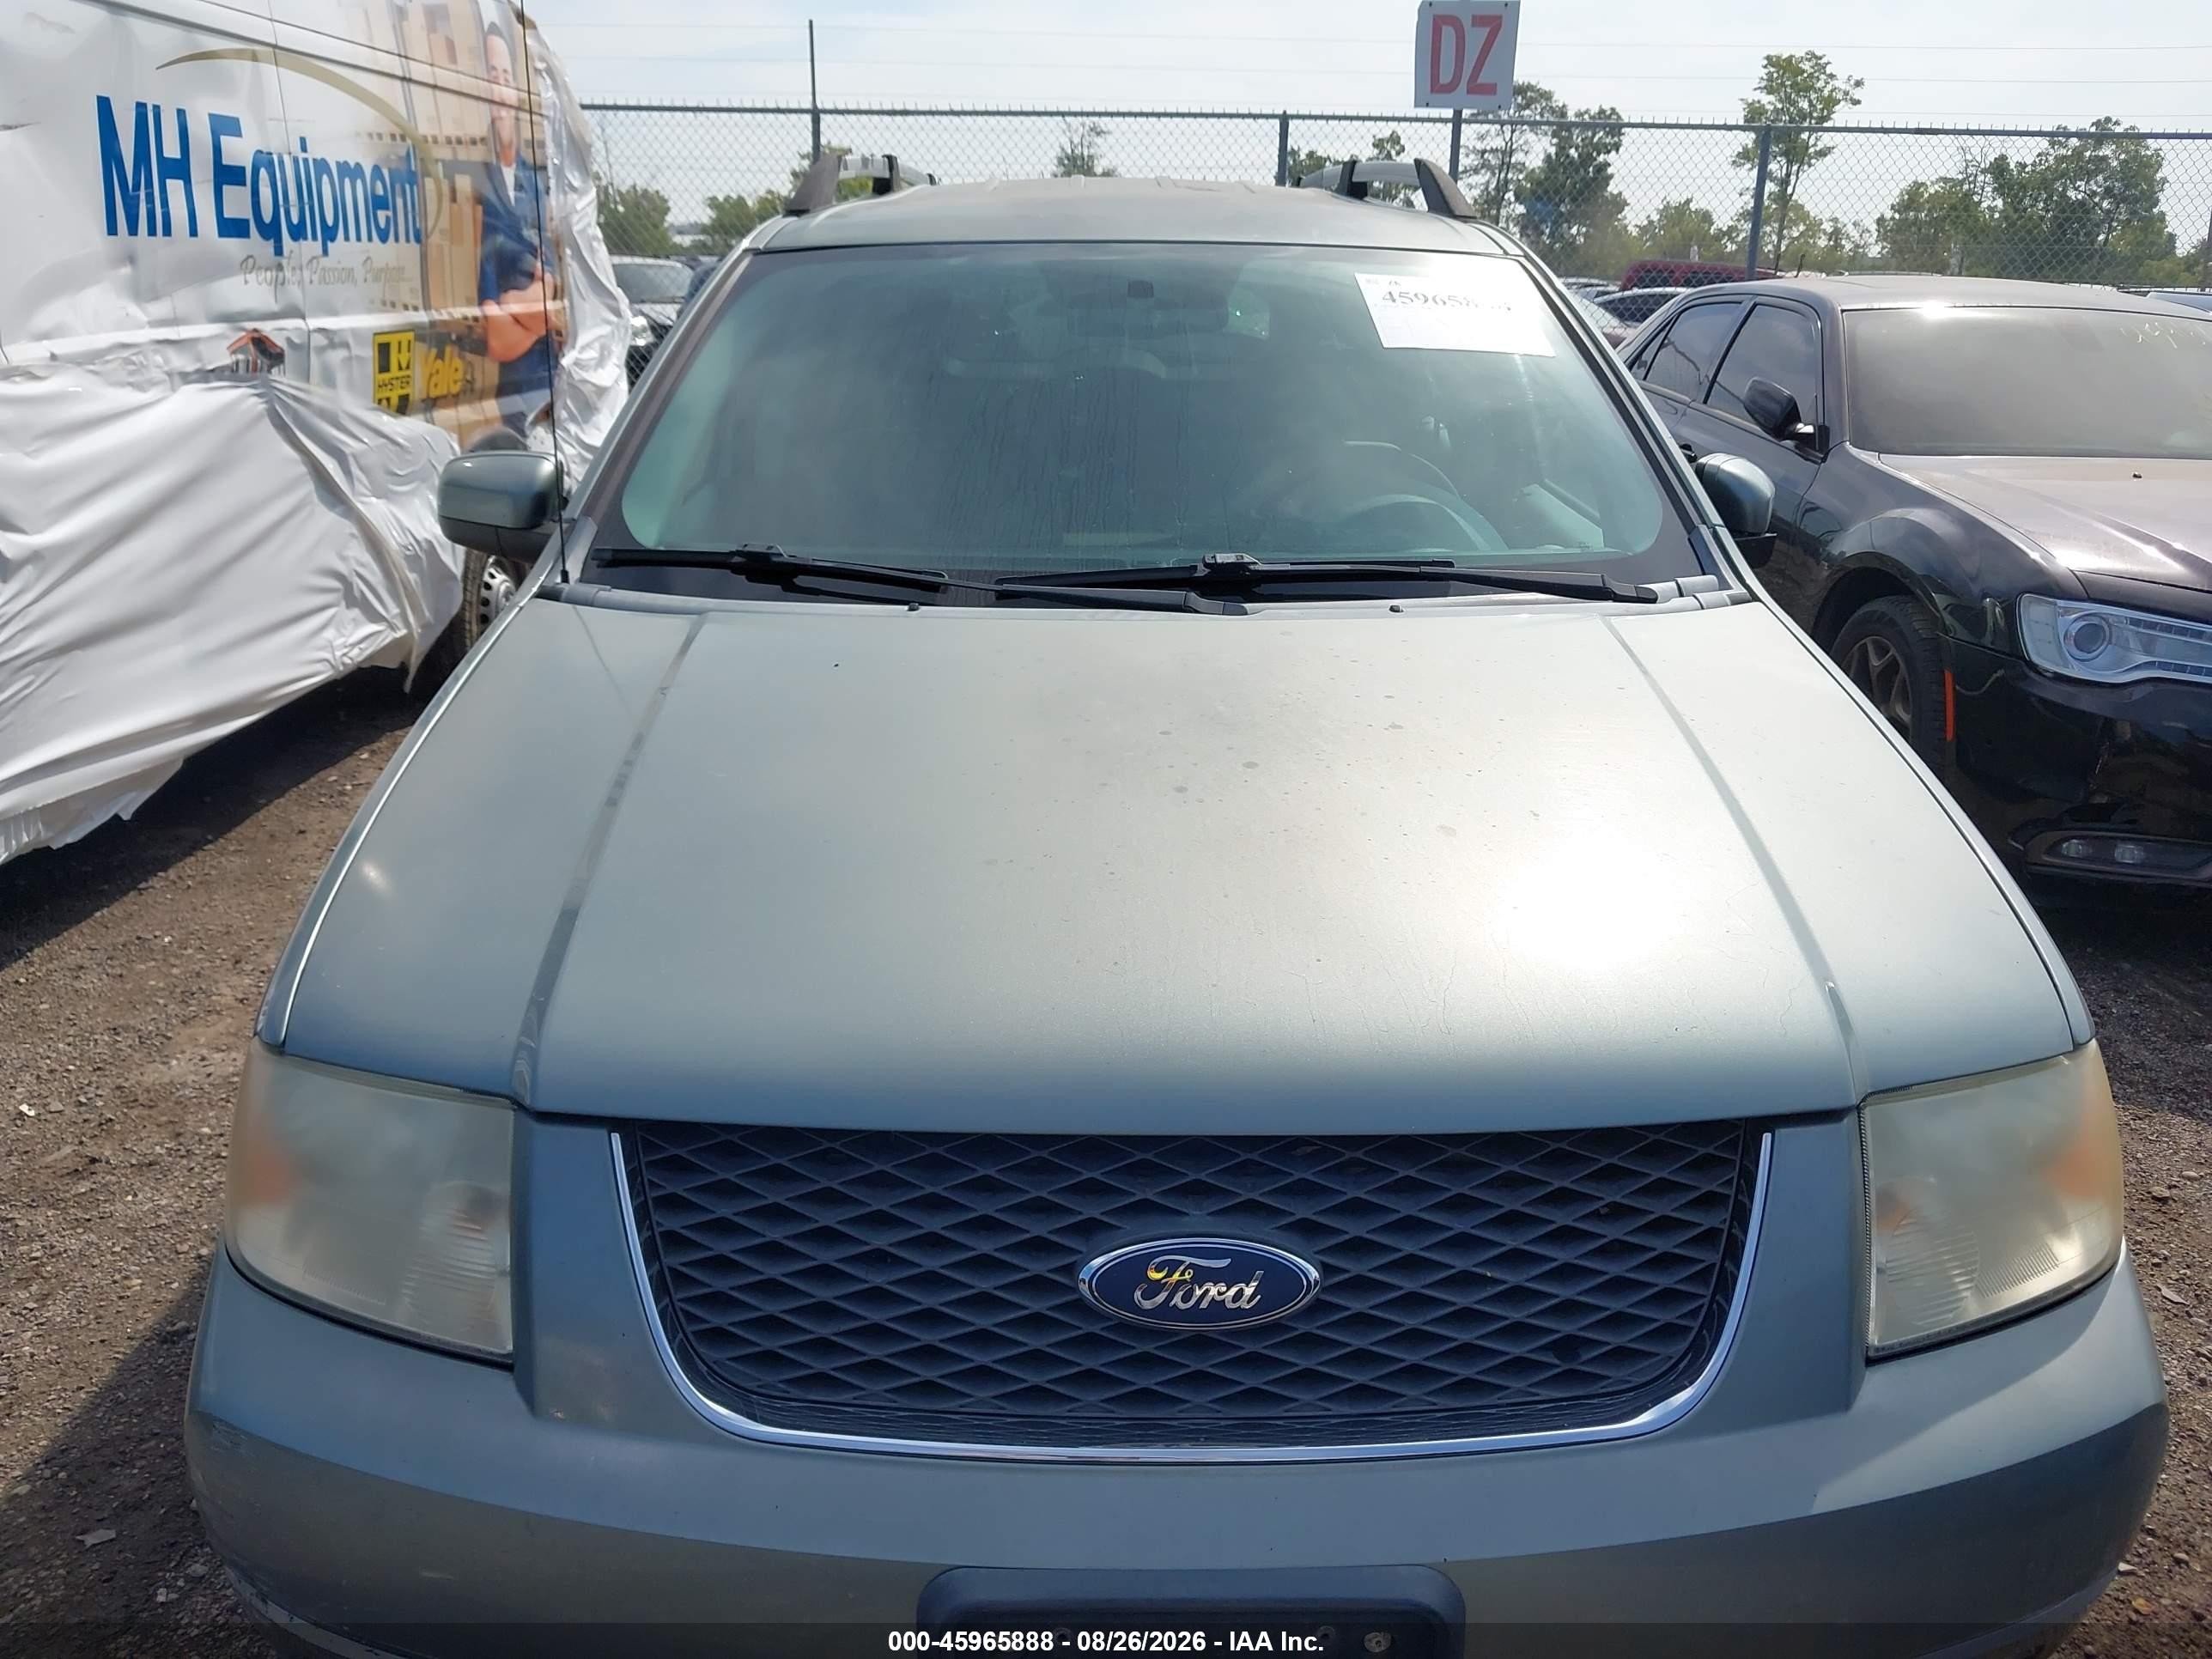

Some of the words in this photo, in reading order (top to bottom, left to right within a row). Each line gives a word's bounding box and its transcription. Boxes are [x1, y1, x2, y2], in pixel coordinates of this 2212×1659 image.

[1430, 14, 1503, 96] DZ
[96, 94, 198, 238] MH
[208, 112, 422, 257] Equipment
[418, 343, 465, 398] Yale
[1134, 1255, 1264, 1310] Ford
